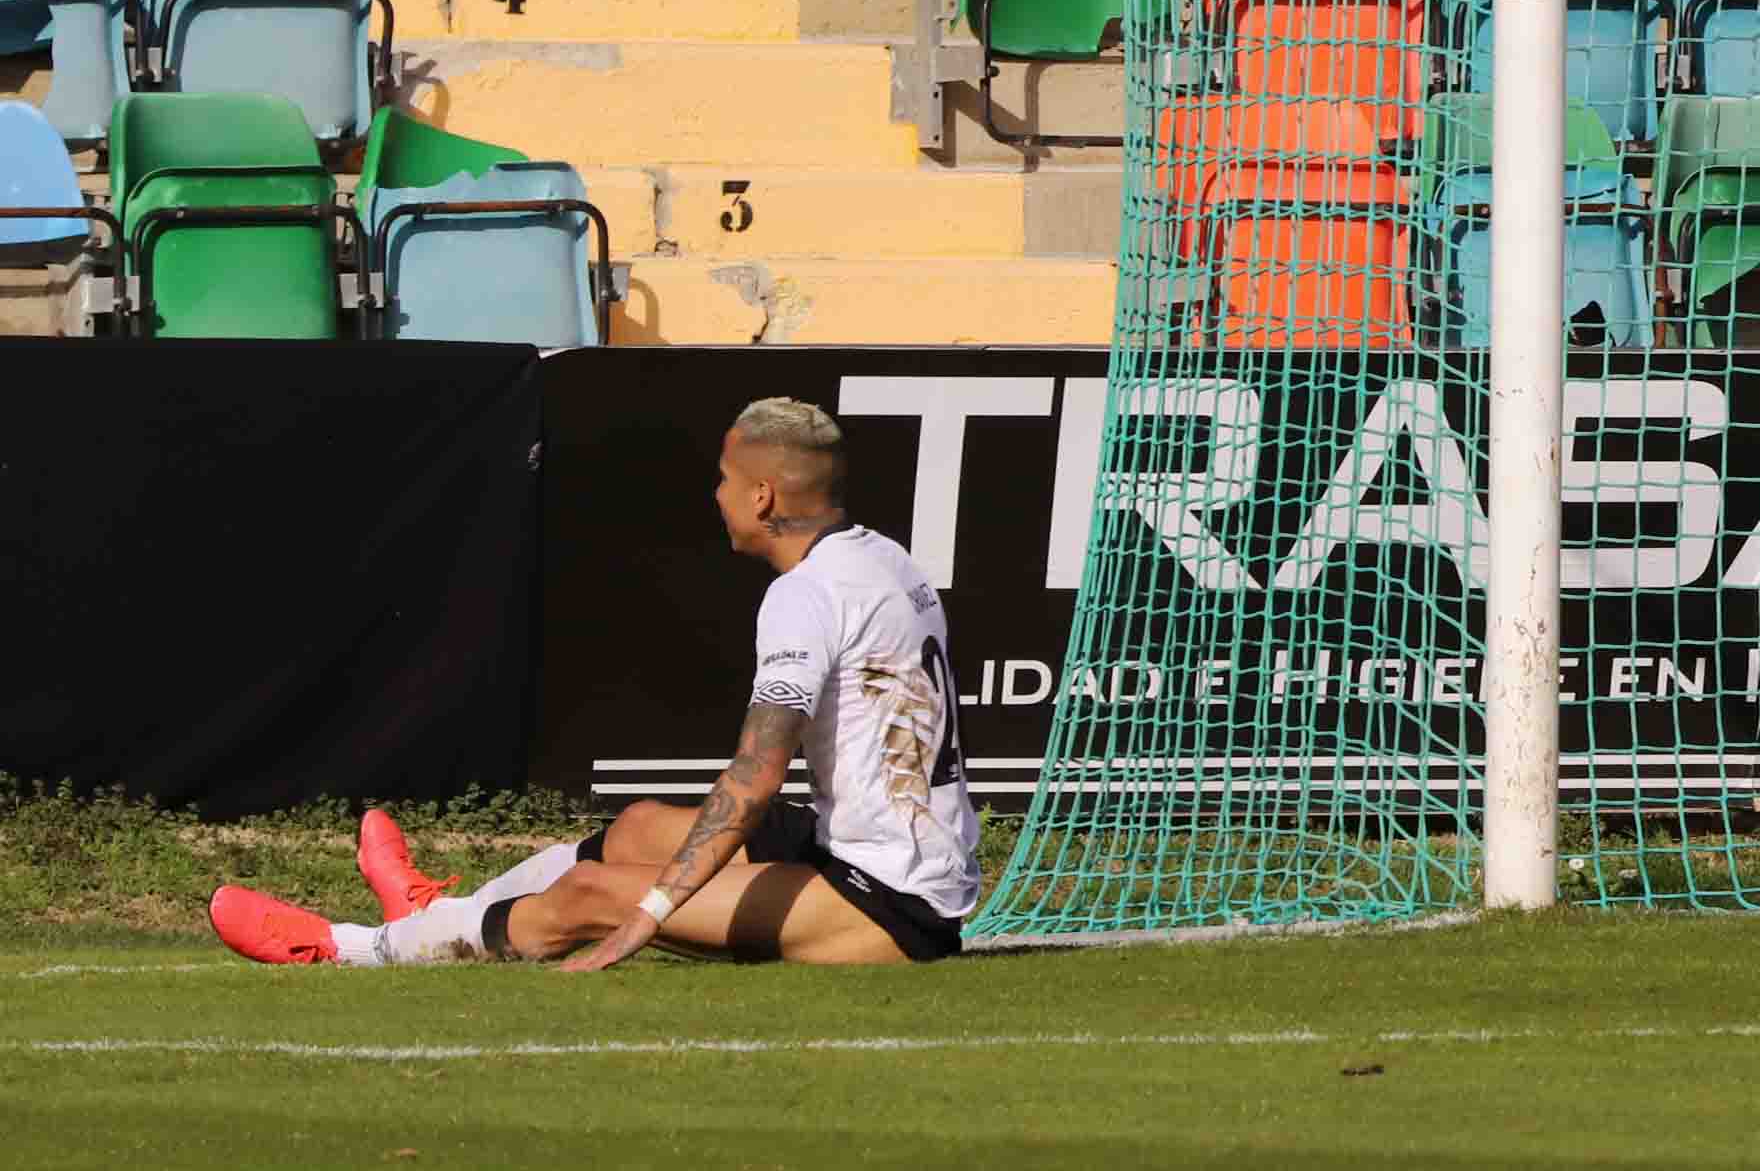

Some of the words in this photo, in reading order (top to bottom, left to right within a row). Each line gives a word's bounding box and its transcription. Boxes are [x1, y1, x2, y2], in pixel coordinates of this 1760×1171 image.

[720, 180, 752, 232] 3
[1195, 659, 1233, 704] E
[1272, 650, 1580, 703] HIGIEE
[1609, 657, 1706, 703] EN
